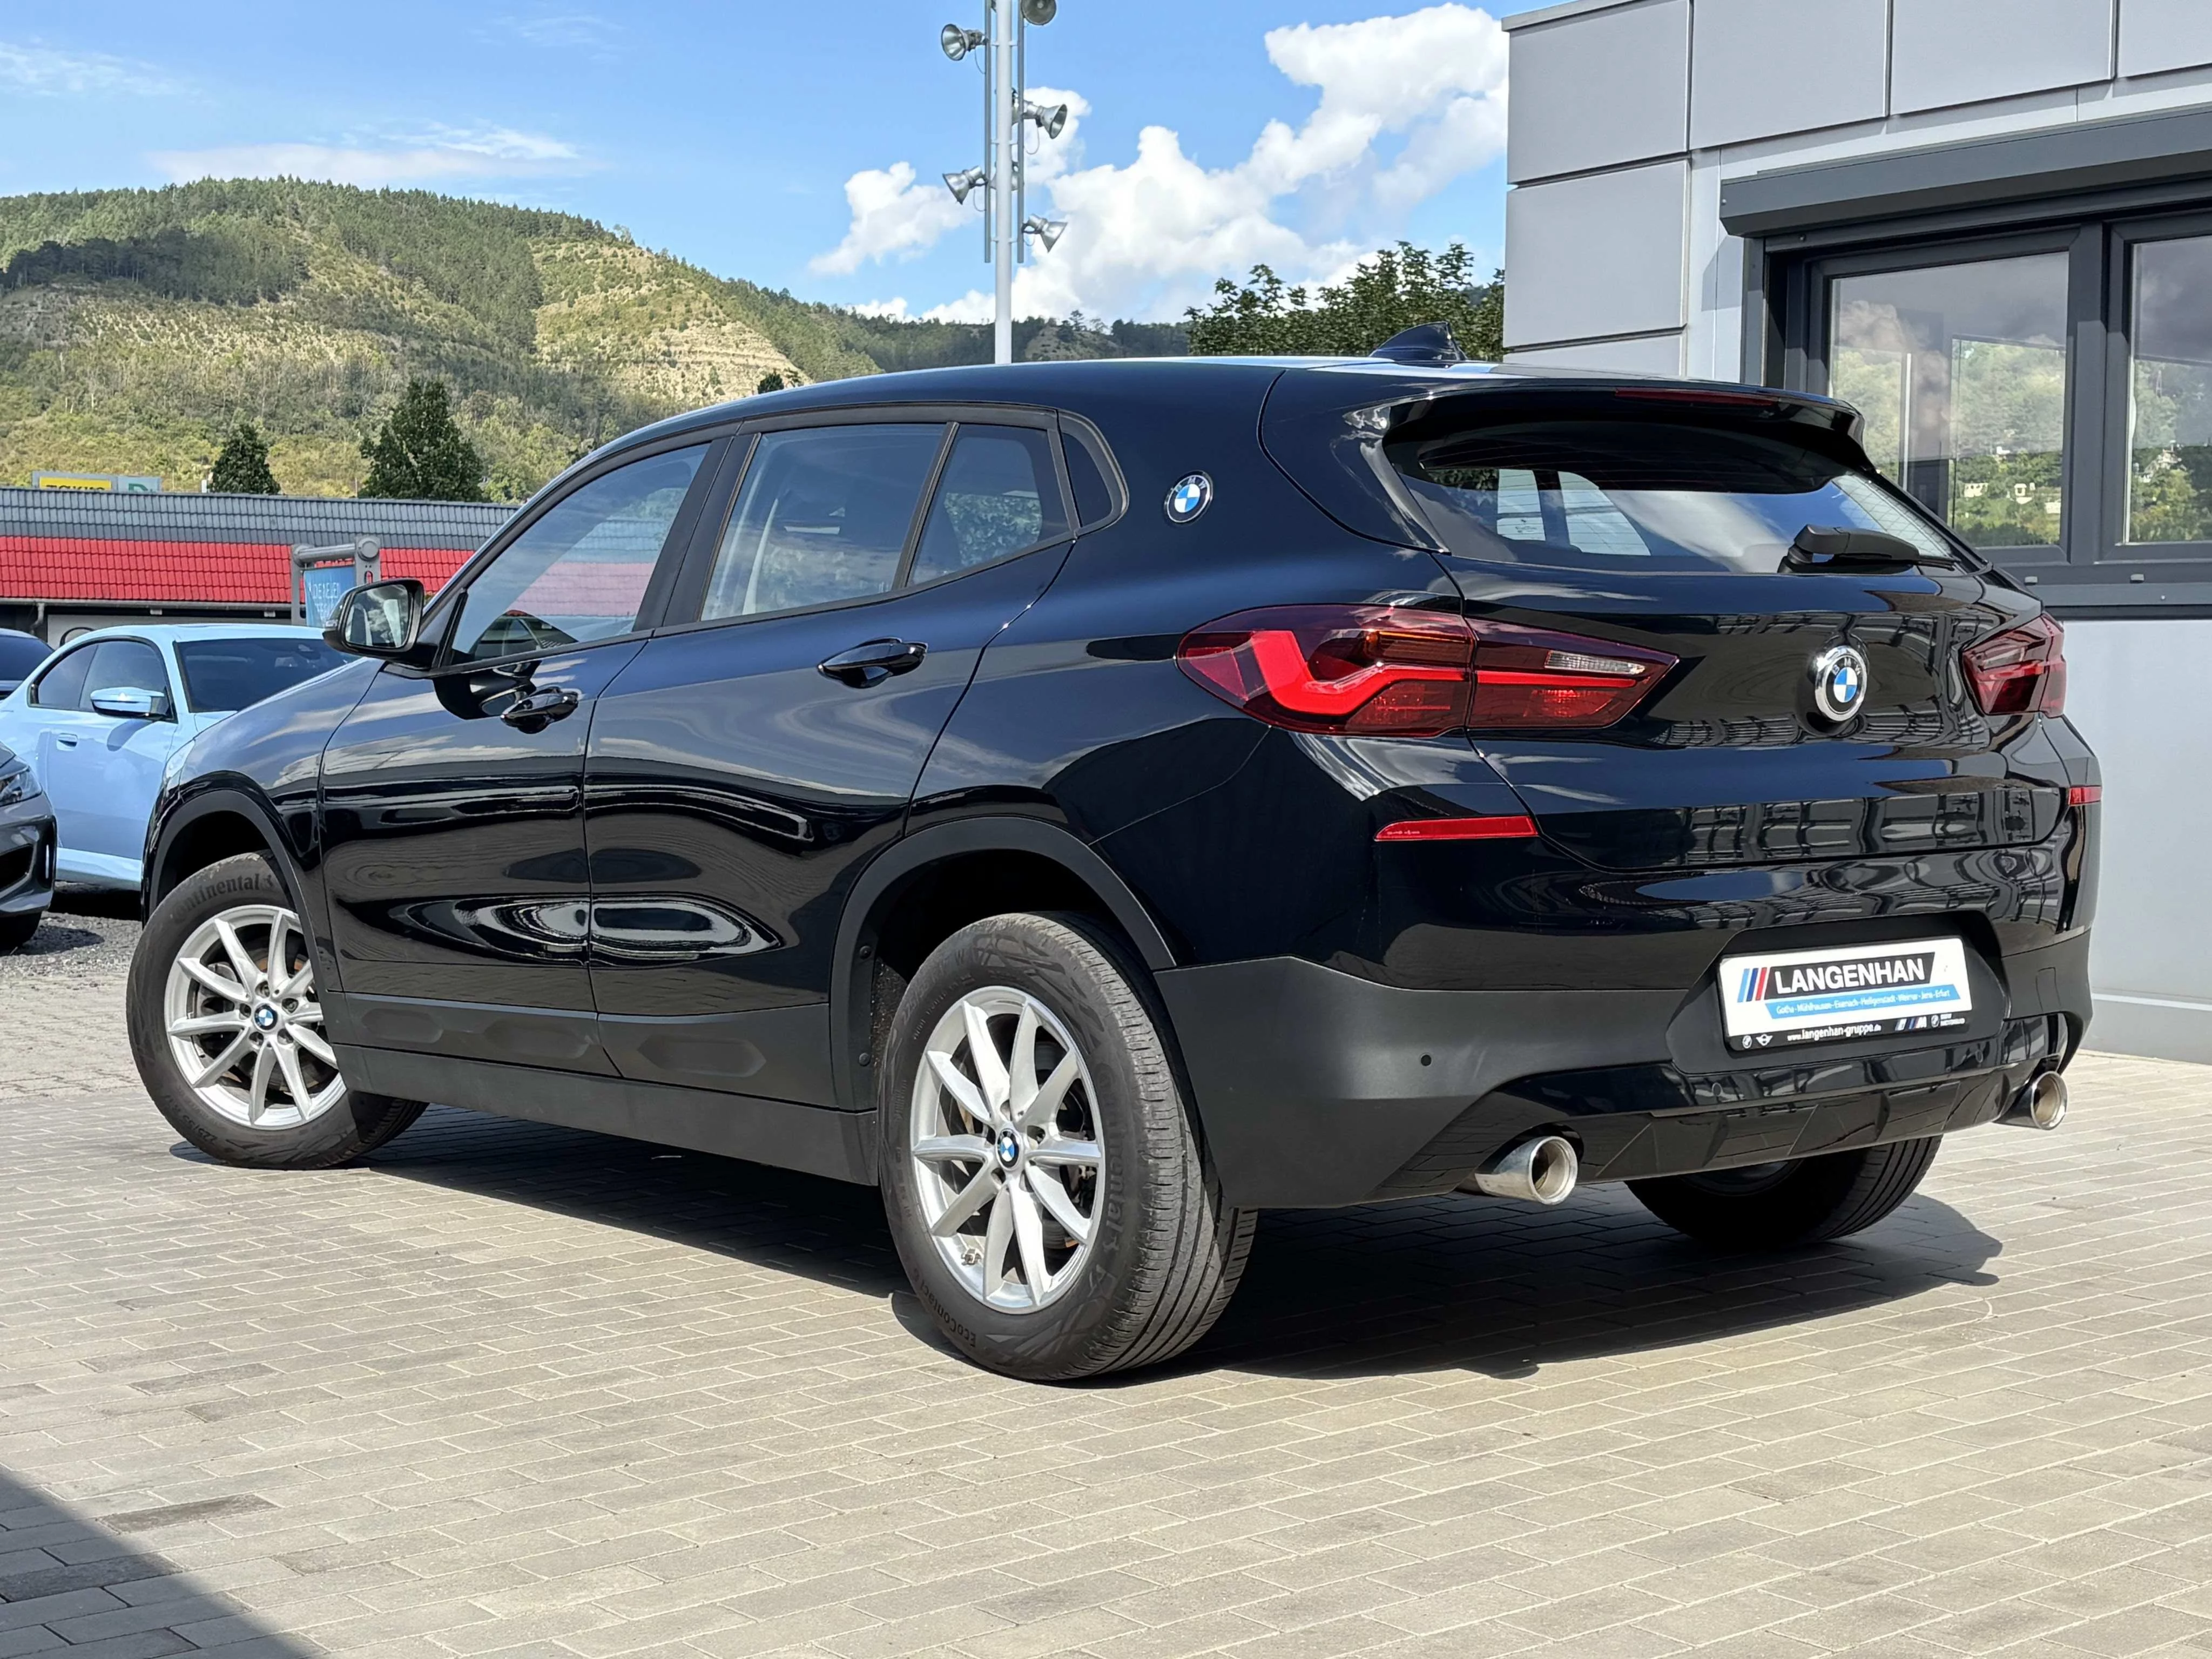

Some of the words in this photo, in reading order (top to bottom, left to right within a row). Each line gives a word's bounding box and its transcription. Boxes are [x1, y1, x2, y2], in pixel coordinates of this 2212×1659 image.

[1775, 957, 1925, 994] LANGENHAN
[1787, 1023, 1881, 1041] www.langenhan-gruppe.de
[920, 1279, 976, 1348] EcoContact
